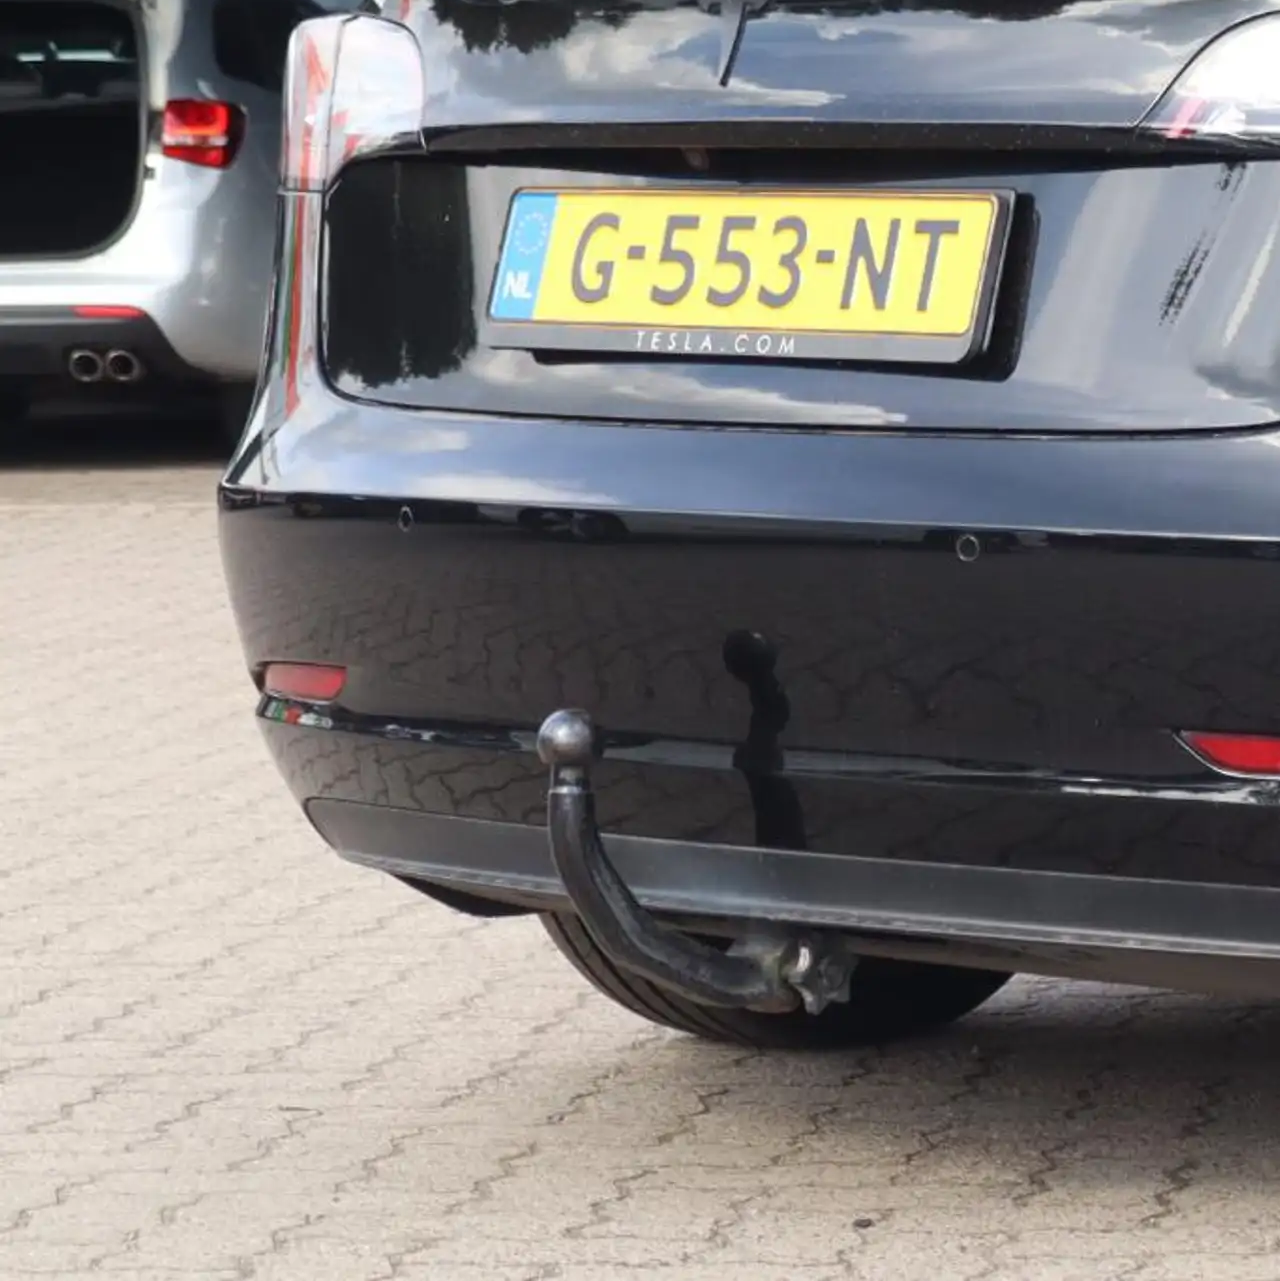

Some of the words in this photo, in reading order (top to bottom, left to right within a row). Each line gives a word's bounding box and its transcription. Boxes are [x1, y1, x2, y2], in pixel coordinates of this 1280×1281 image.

[571, 212, 960, 312] G-553-NT
[502, 271, 532, 300] NL
[634, 331, 796, 355] TESLA.COM
